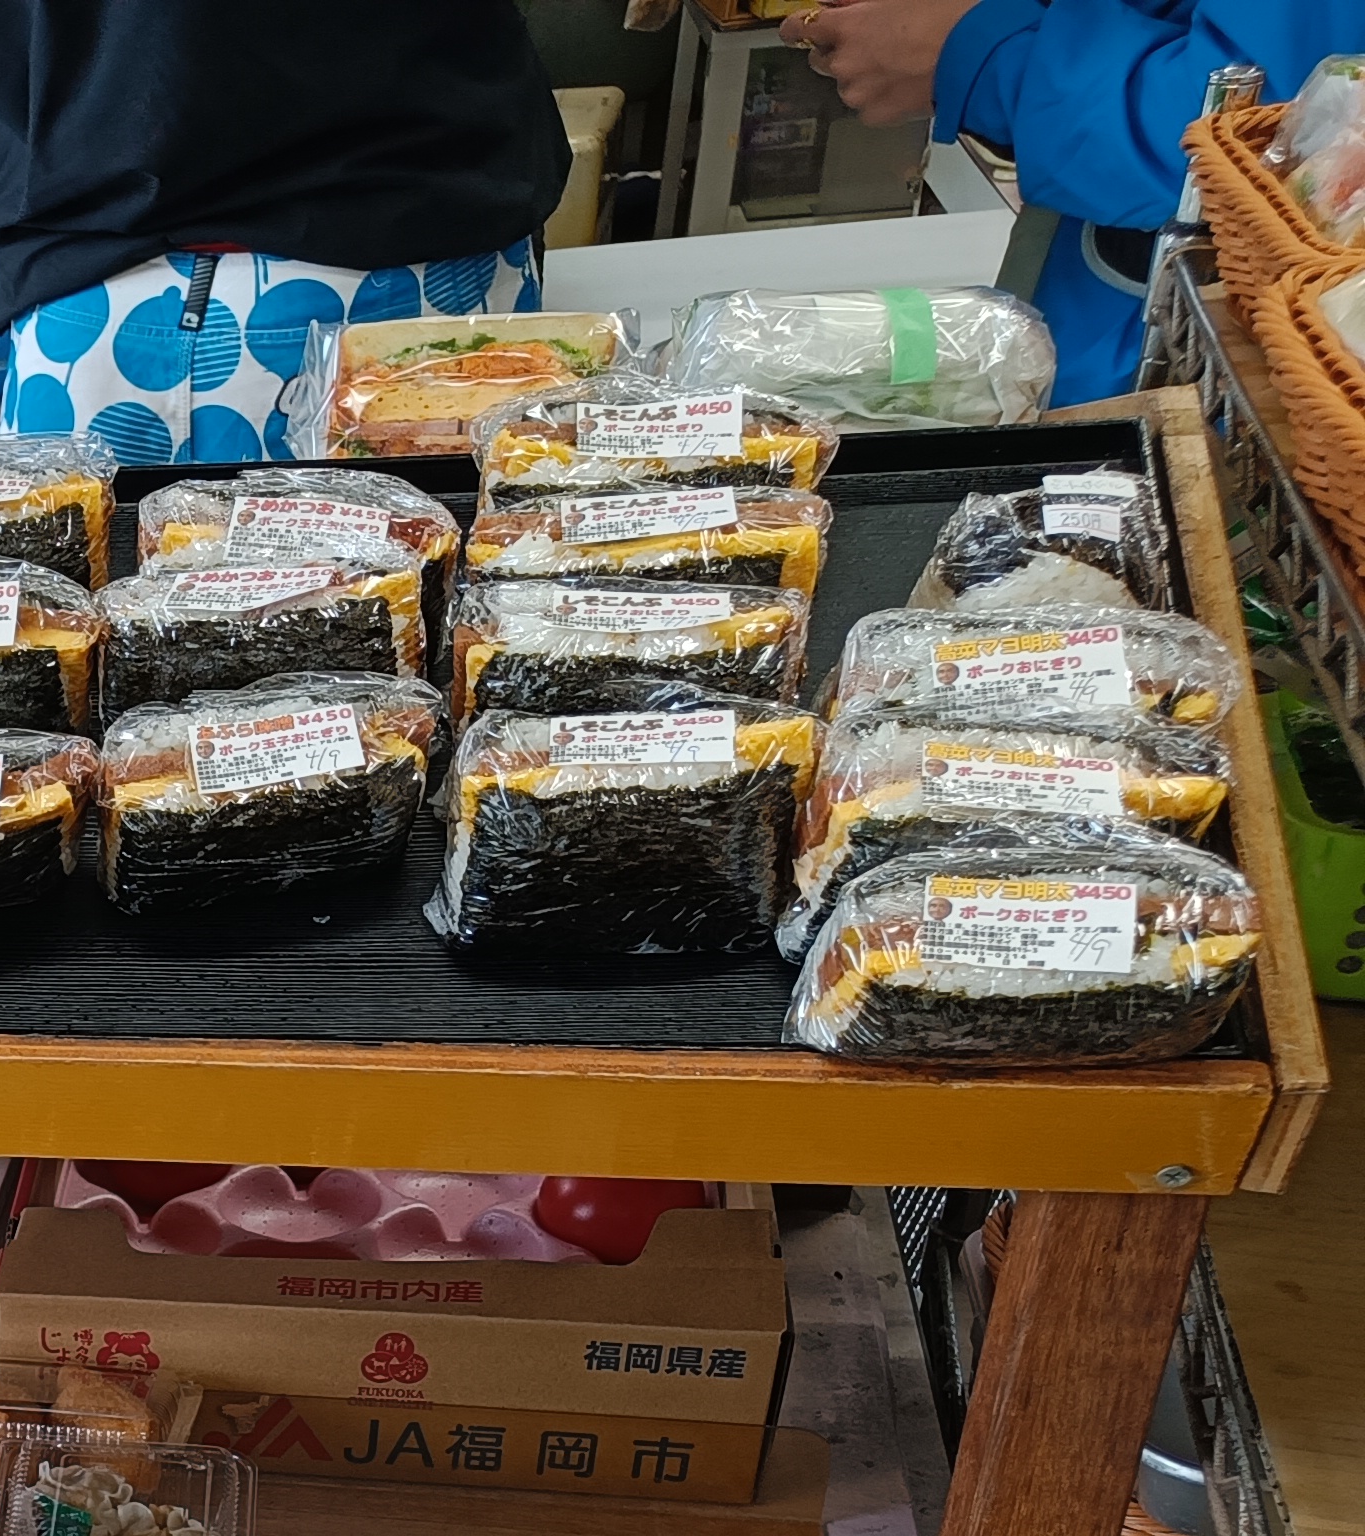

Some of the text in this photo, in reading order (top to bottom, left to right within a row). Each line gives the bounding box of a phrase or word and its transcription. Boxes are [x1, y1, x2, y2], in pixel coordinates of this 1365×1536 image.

[582, 401, 732, 421] しそこんぶ ¥450
[603, 423, 703, 433] ポークおにぎり
[243, 499, 389, 521] うめかつお ¥450
[569, 490, 725, 512] しそこんぶ ¥450
[592, 504, 697, 521] ポークおにぎり
[1059, 511, 1101, 529] 250円
[185, 569, 334, 583] うめかつお ¥450
[562, 595, 720, 607] しそこんぶ ¥450
[583, 607, 690, 617] ポークおにぎり
[934, 627, 1118, 663] 高菜マヨ明太 ¥450
[966, 656, 1081, 679] ポークおにぎり
[197, 707, 353, 740] あぶら味噌 ¥450
[559, 714, 724, 733] しそこんぶ ¥450
[219, 725, 348, 756] ポーク玉子おにぎり
[581, 730, 692, 743] ポークおにぎり
[924, 743, 1114, 772] 高菜マヨ明太 ¥450
[955, 766, 1075, 784] ポークおにぎり
[928, 878, 1131, 902] 高菜マヨ明太 ¥450
[960, 906, 1087, 923] ポークおにぎり
[276, 1275, 484, 1304] 福岡市内産
[584, 1341, 747, 1379] 福岡県産
[357, 1387, 425, 1400] FUKUOKA
[344, 1419, 696, 1485] JA福岡市
